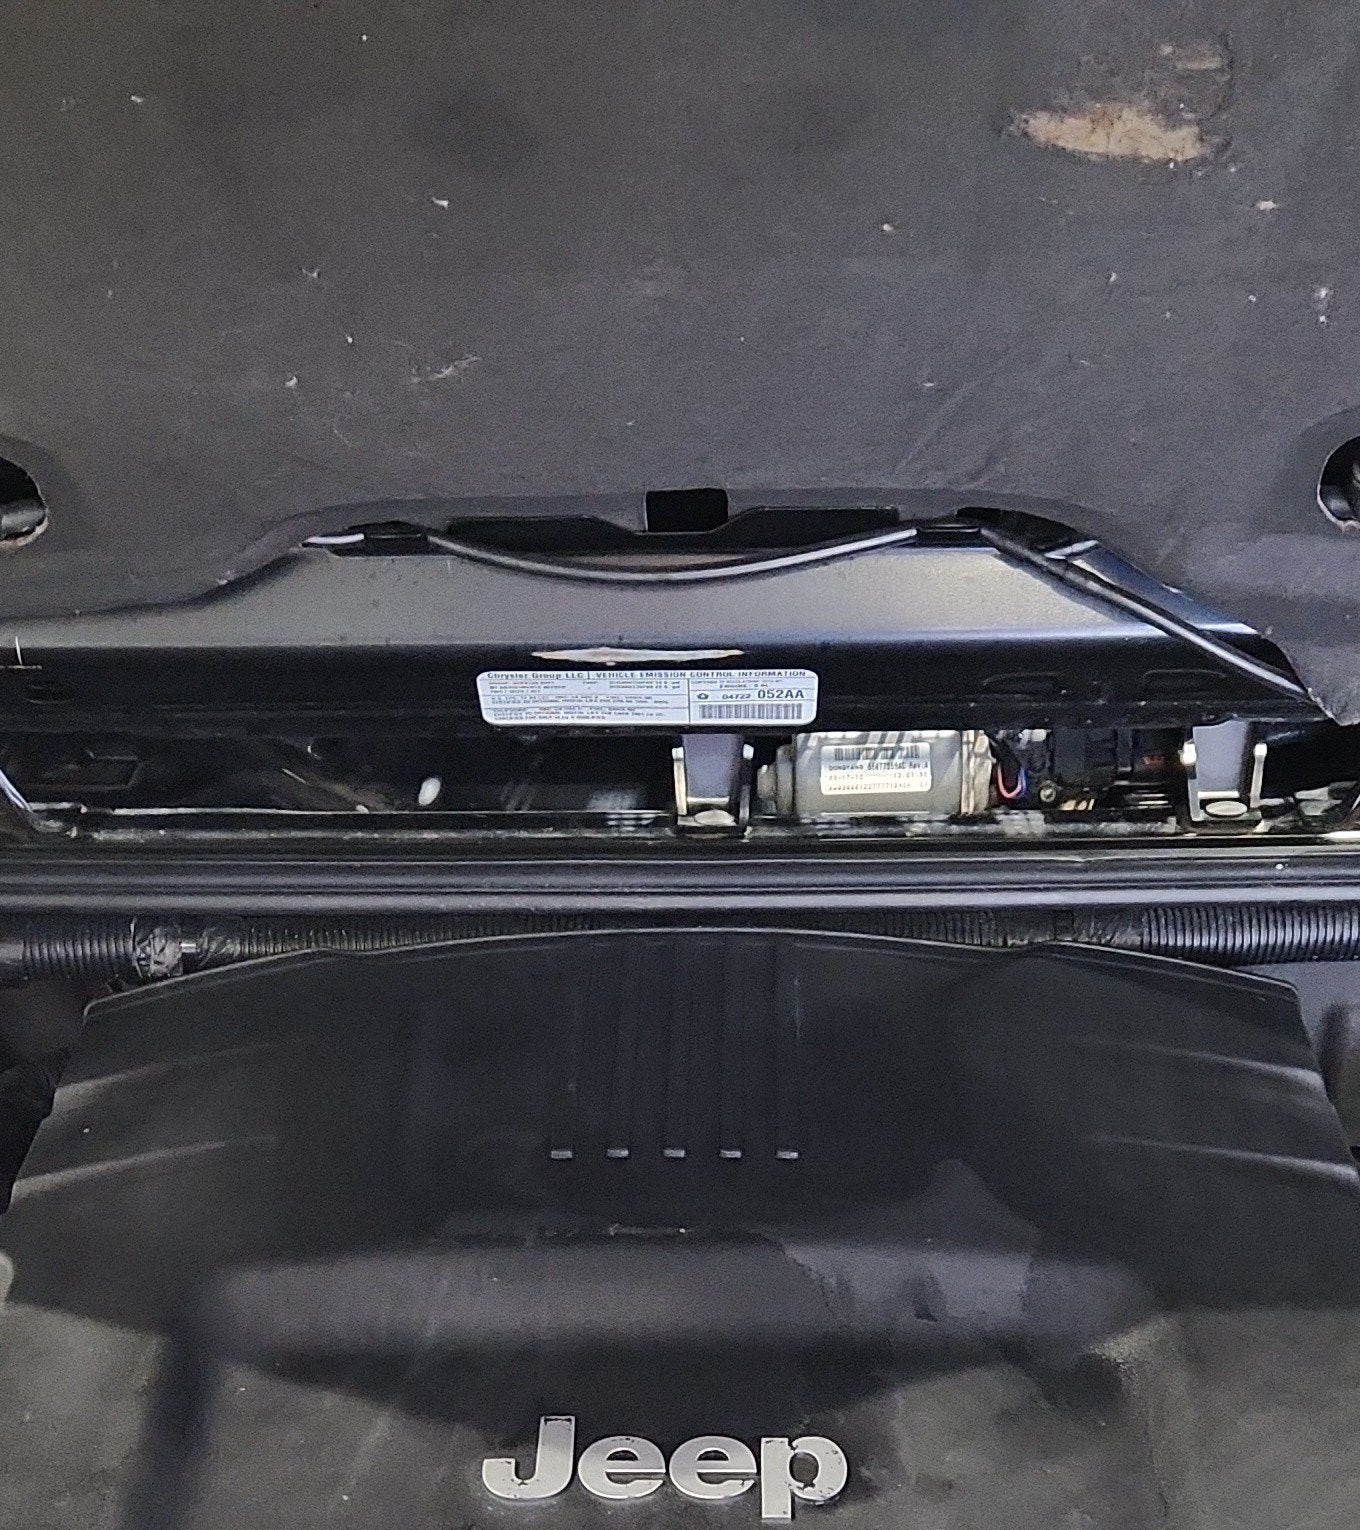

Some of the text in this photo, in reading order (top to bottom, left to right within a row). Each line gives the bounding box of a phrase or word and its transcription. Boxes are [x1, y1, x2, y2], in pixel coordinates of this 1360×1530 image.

[487, 672, 528, 681] Chrysler
[532, 672, 562, 680] Group
[596, 671, 635, 679] VEHICLE
[738, 670, 806, 678] INFORMATION
[757, 689, 805, 699] 052AA
[480, 1414, 849, 1520] Jeep
